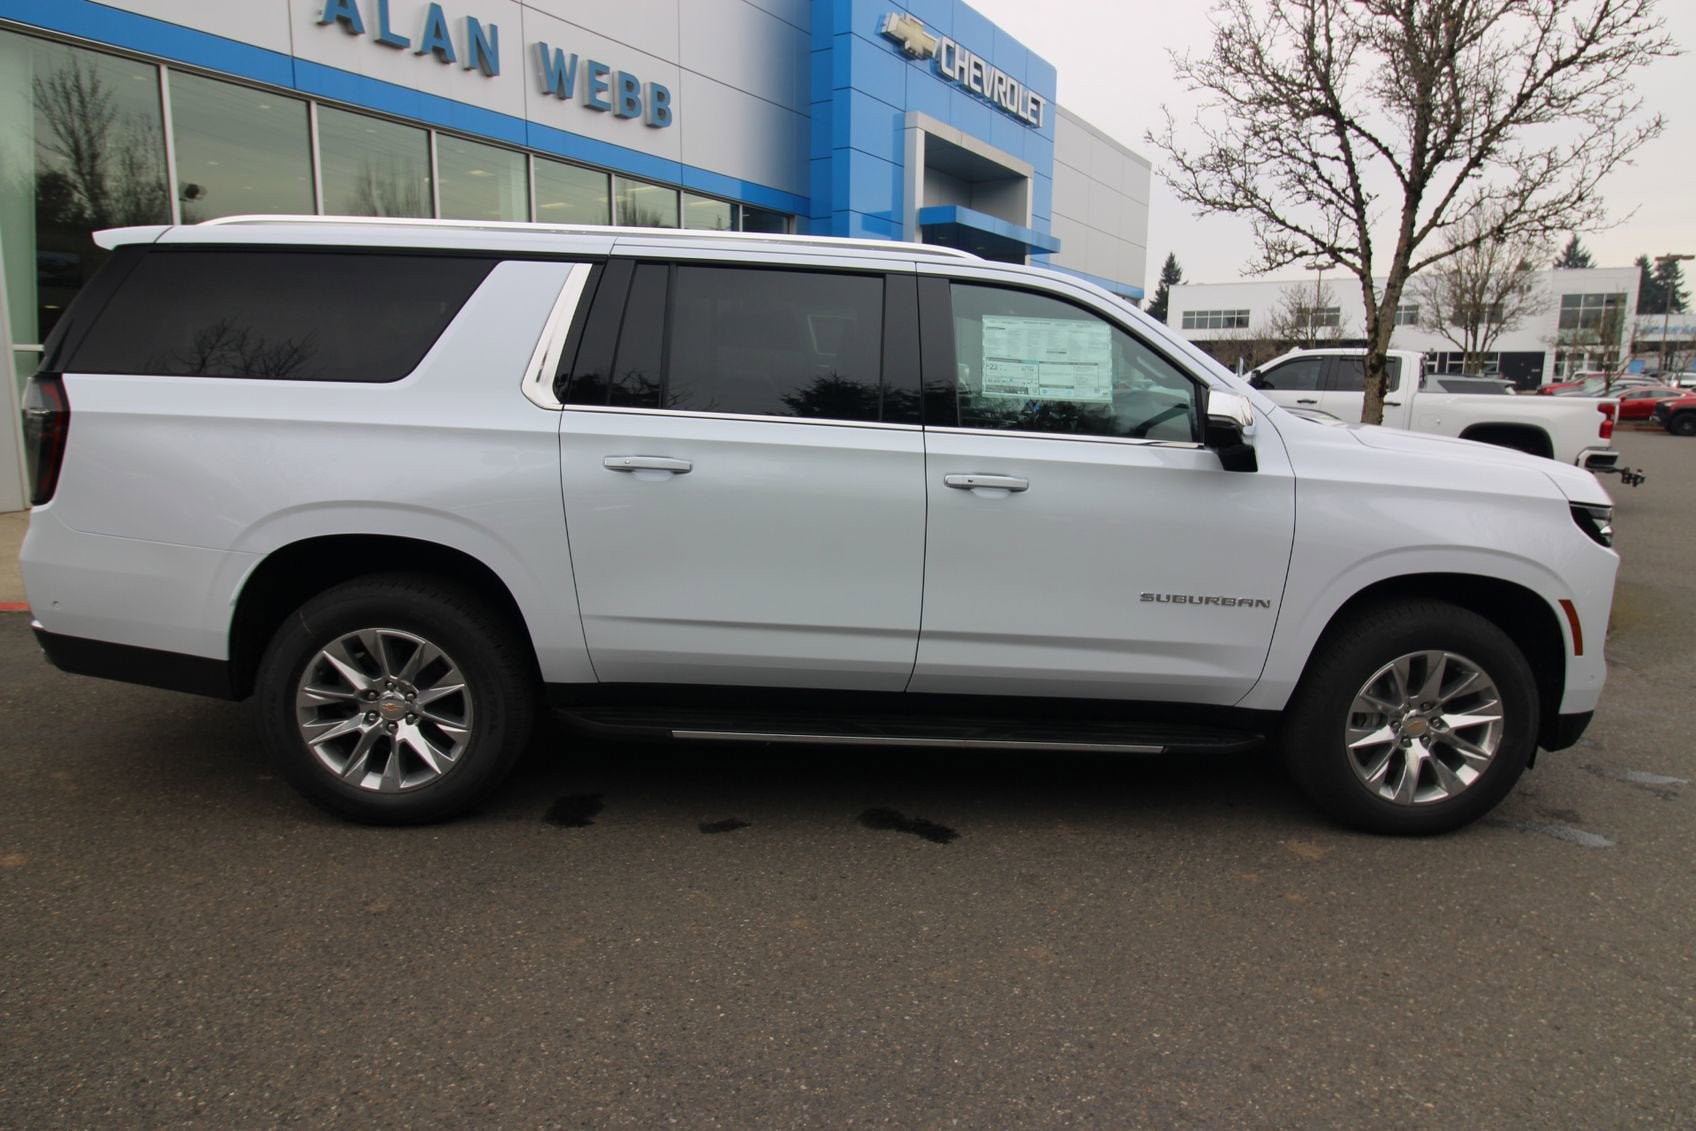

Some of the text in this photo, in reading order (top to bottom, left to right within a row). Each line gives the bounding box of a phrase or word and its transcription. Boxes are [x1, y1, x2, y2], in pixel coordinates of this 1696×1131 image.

[317, 0, 672, 128] ALAN WEBB
[937, 35, 1046, 128] CHEVROLET
[1140, 592, 1271, 608] SUBURBAN
